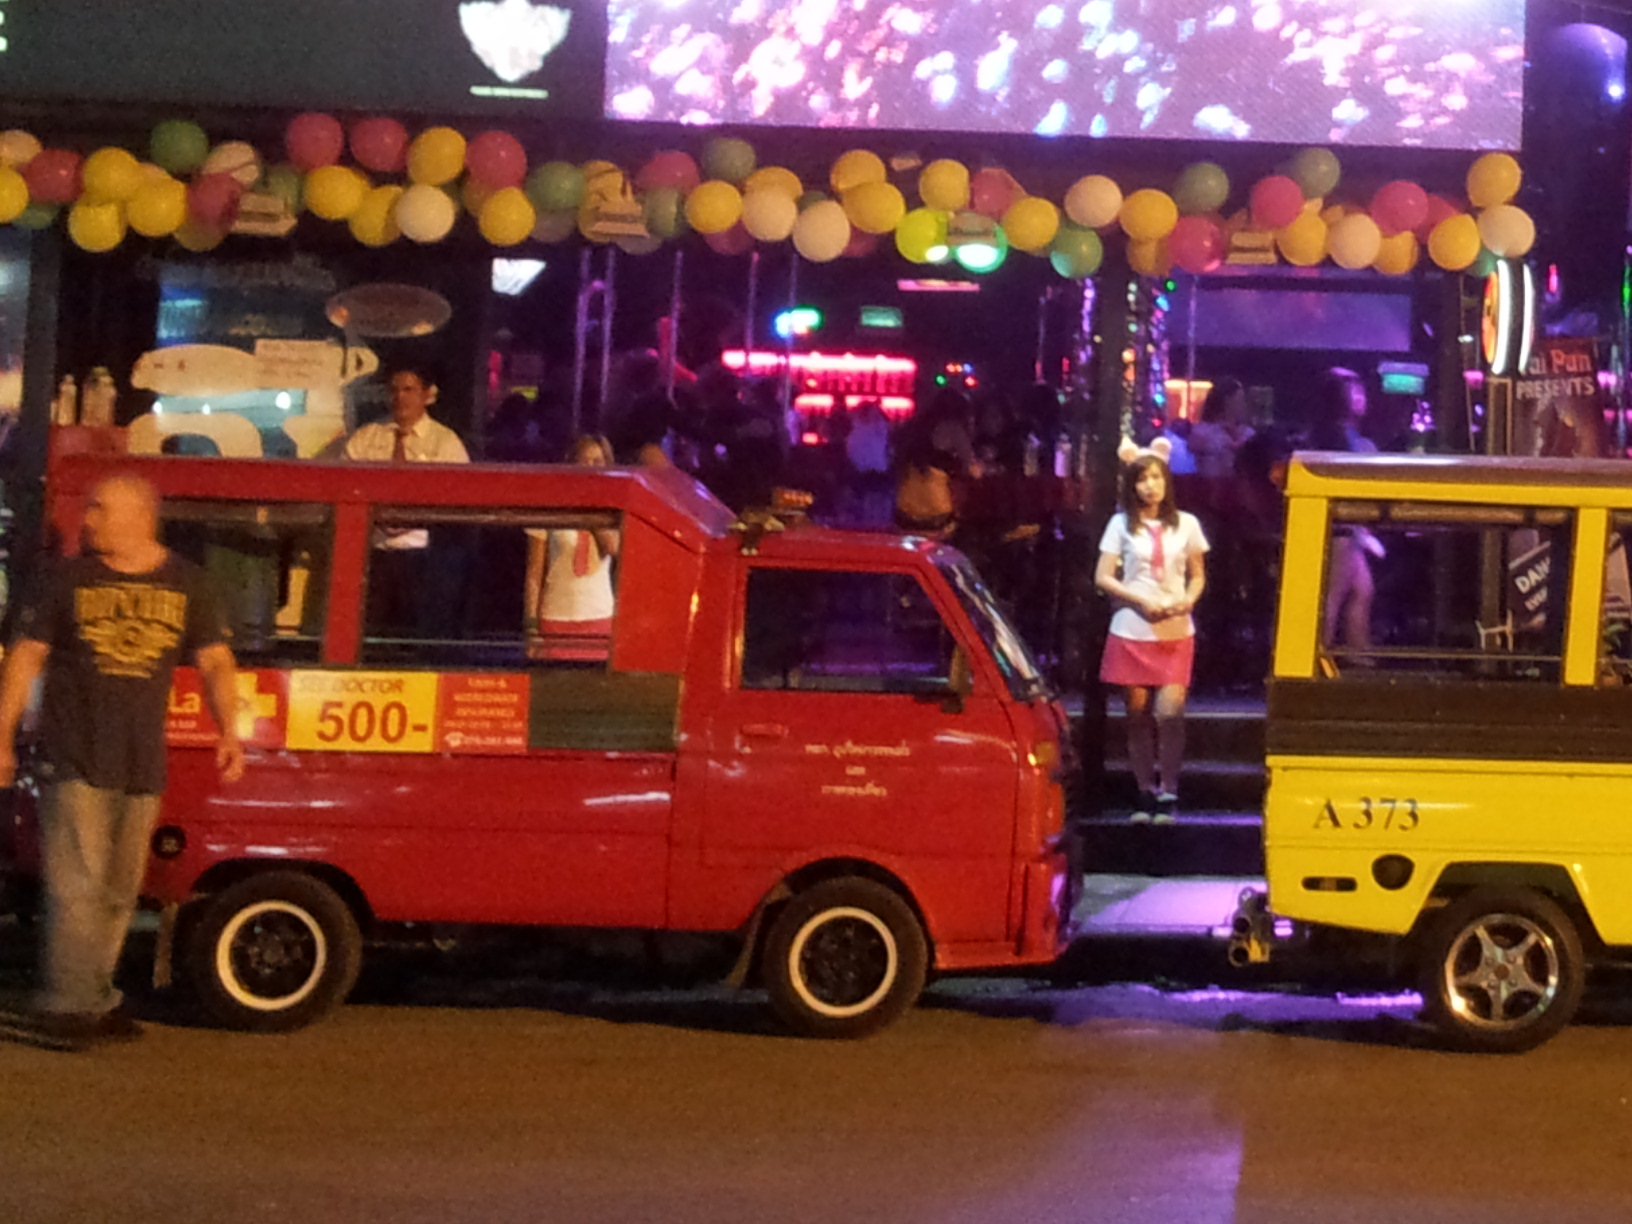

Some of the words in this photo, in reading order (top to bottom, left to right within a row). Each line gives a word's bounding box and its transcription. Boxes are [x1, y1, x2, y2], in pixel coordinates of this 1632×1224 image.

[1516, 376, 1596, 400] PRESENTS
[1312, 796, 1343, 830] A
[1351, 795, 1420, 832] 373
